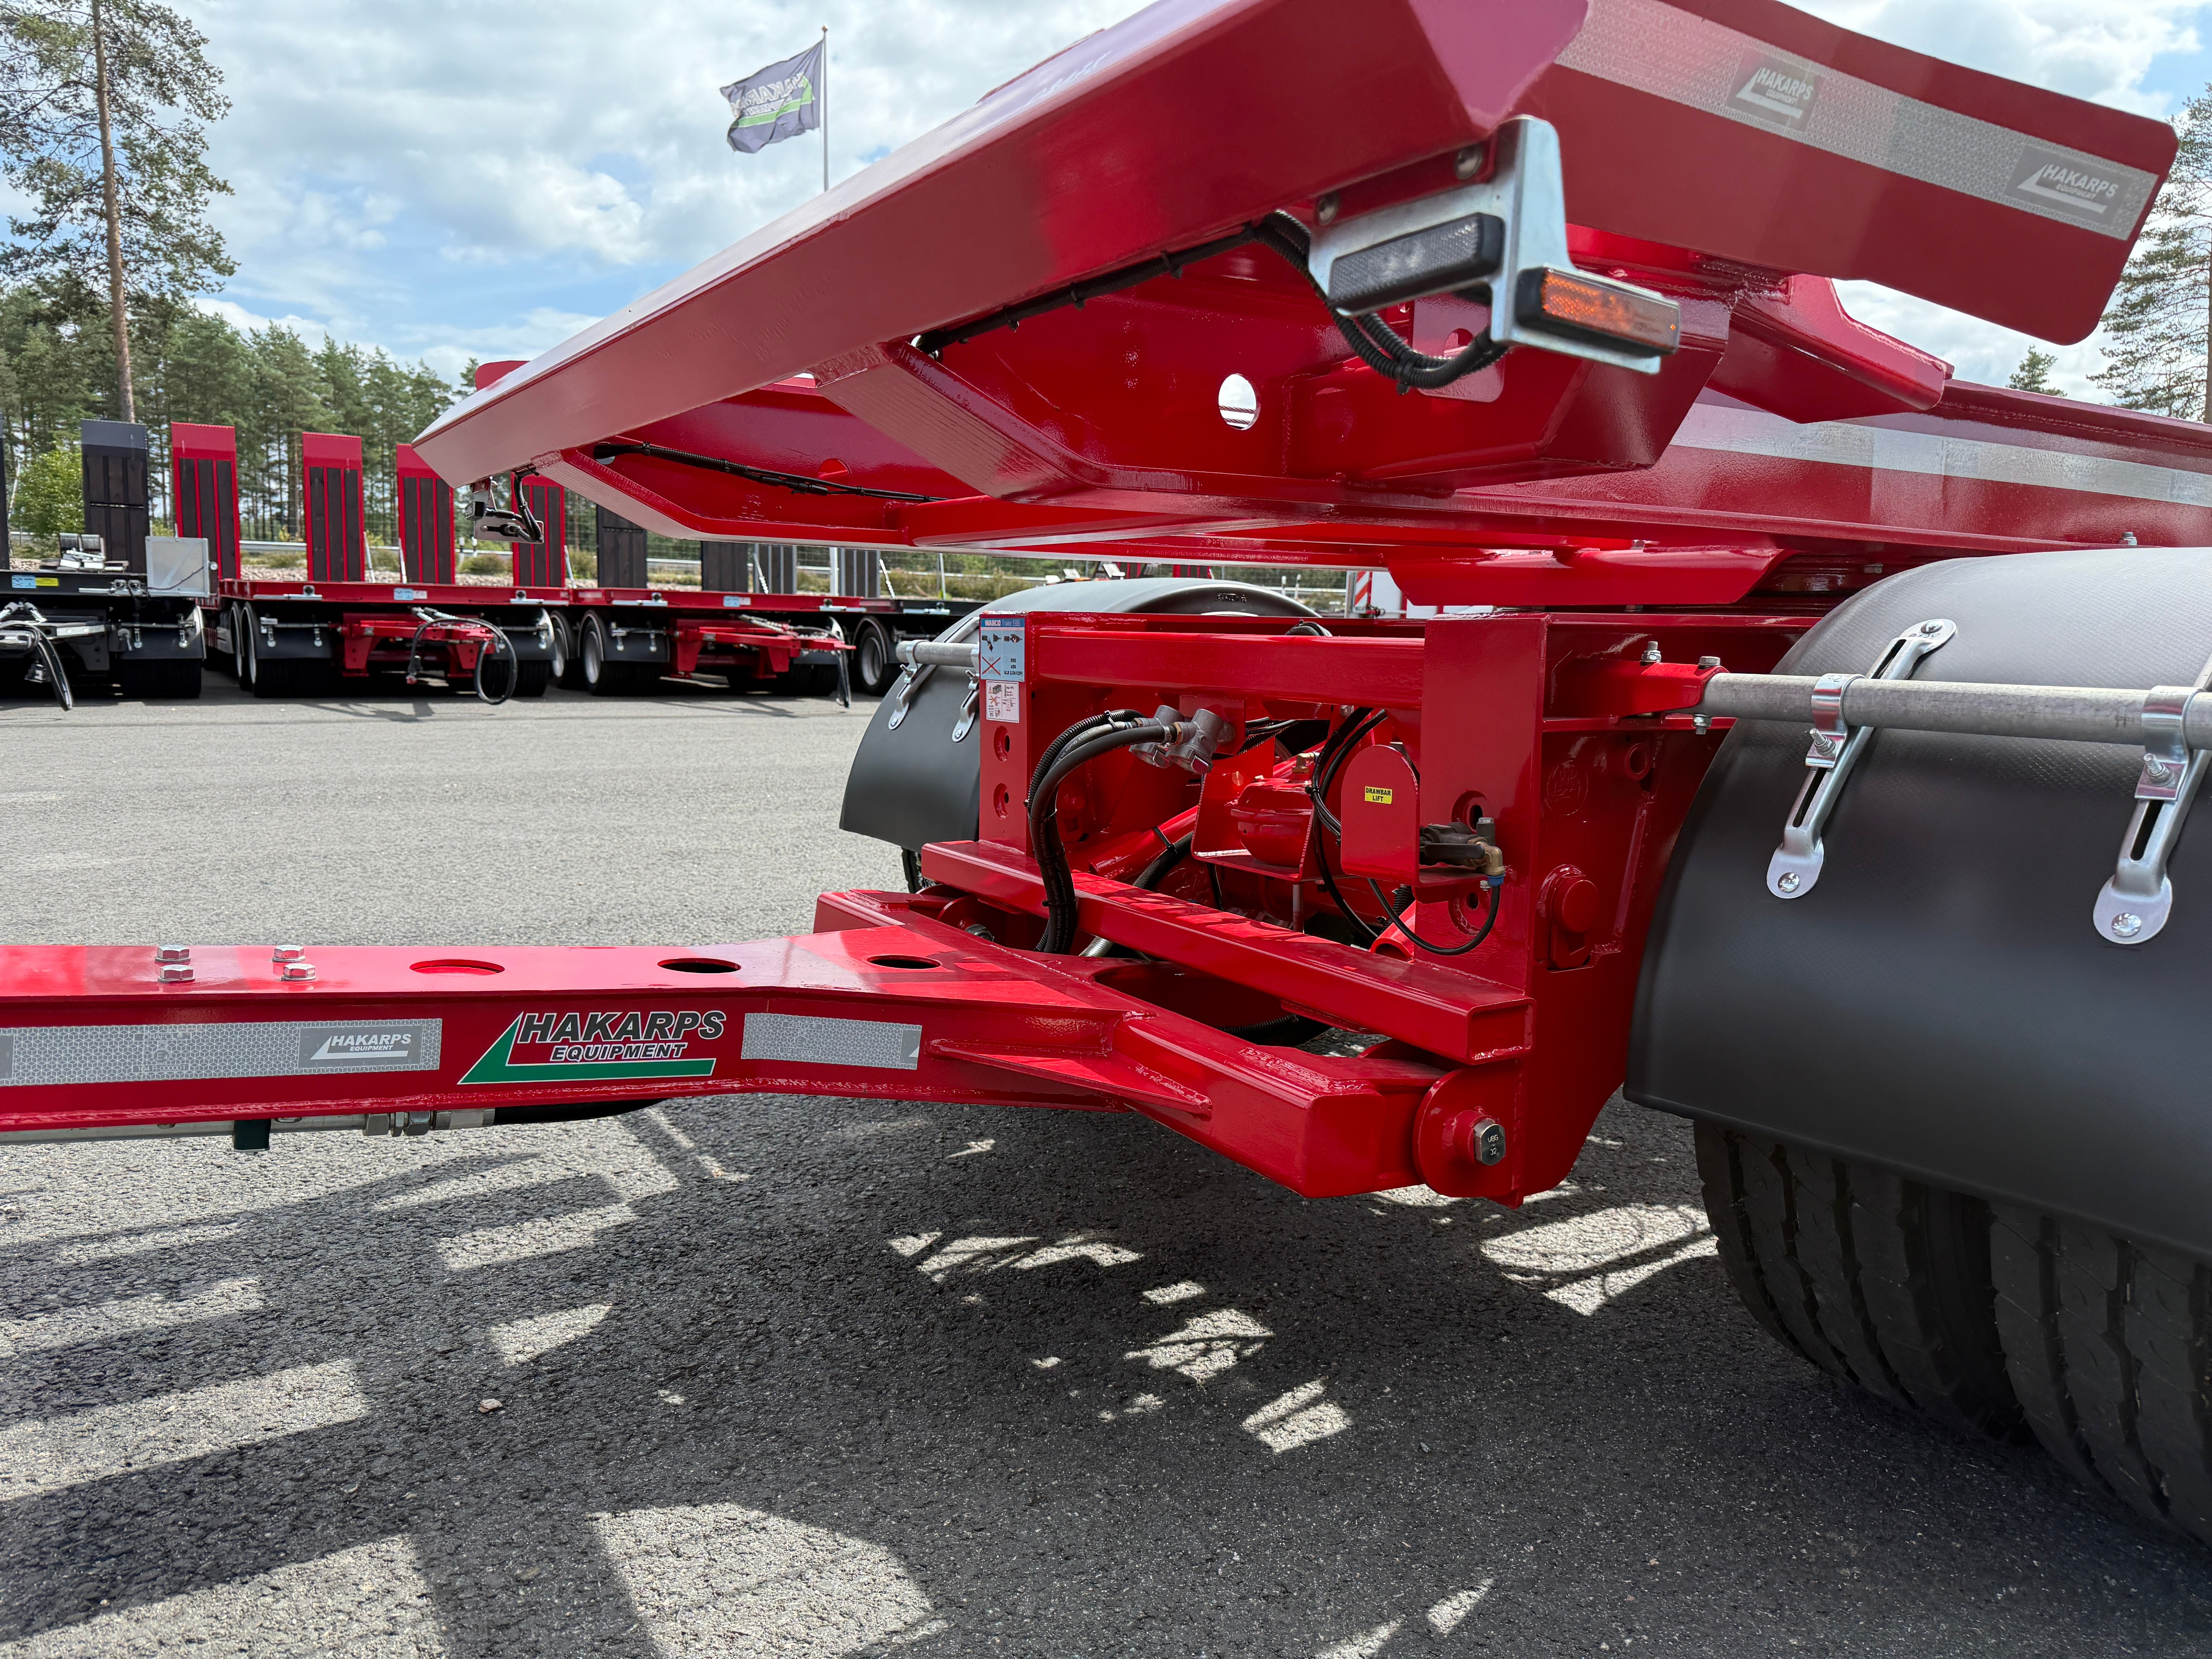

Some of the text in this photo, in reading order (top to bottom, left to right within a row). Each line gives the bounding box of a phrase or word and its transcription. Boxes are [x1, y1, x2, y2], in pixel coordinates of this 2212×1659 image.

[1756, 67, 1813, 100] HAKARPS
[1766, 89, 1798, 104] EQUIPMENT
[2043, 164, 2119, 198] HAKARPS
[2056, 183, 2097, 200] EQUIPMENT
[1366, 788, 1391, 796] DRAWBAR
[517, 1011, 726, 1043] HAKARPS
[331, 1034, 412, 1046] HAKARPS
[550, 1042, 687, 1062] EQUIPMENT
